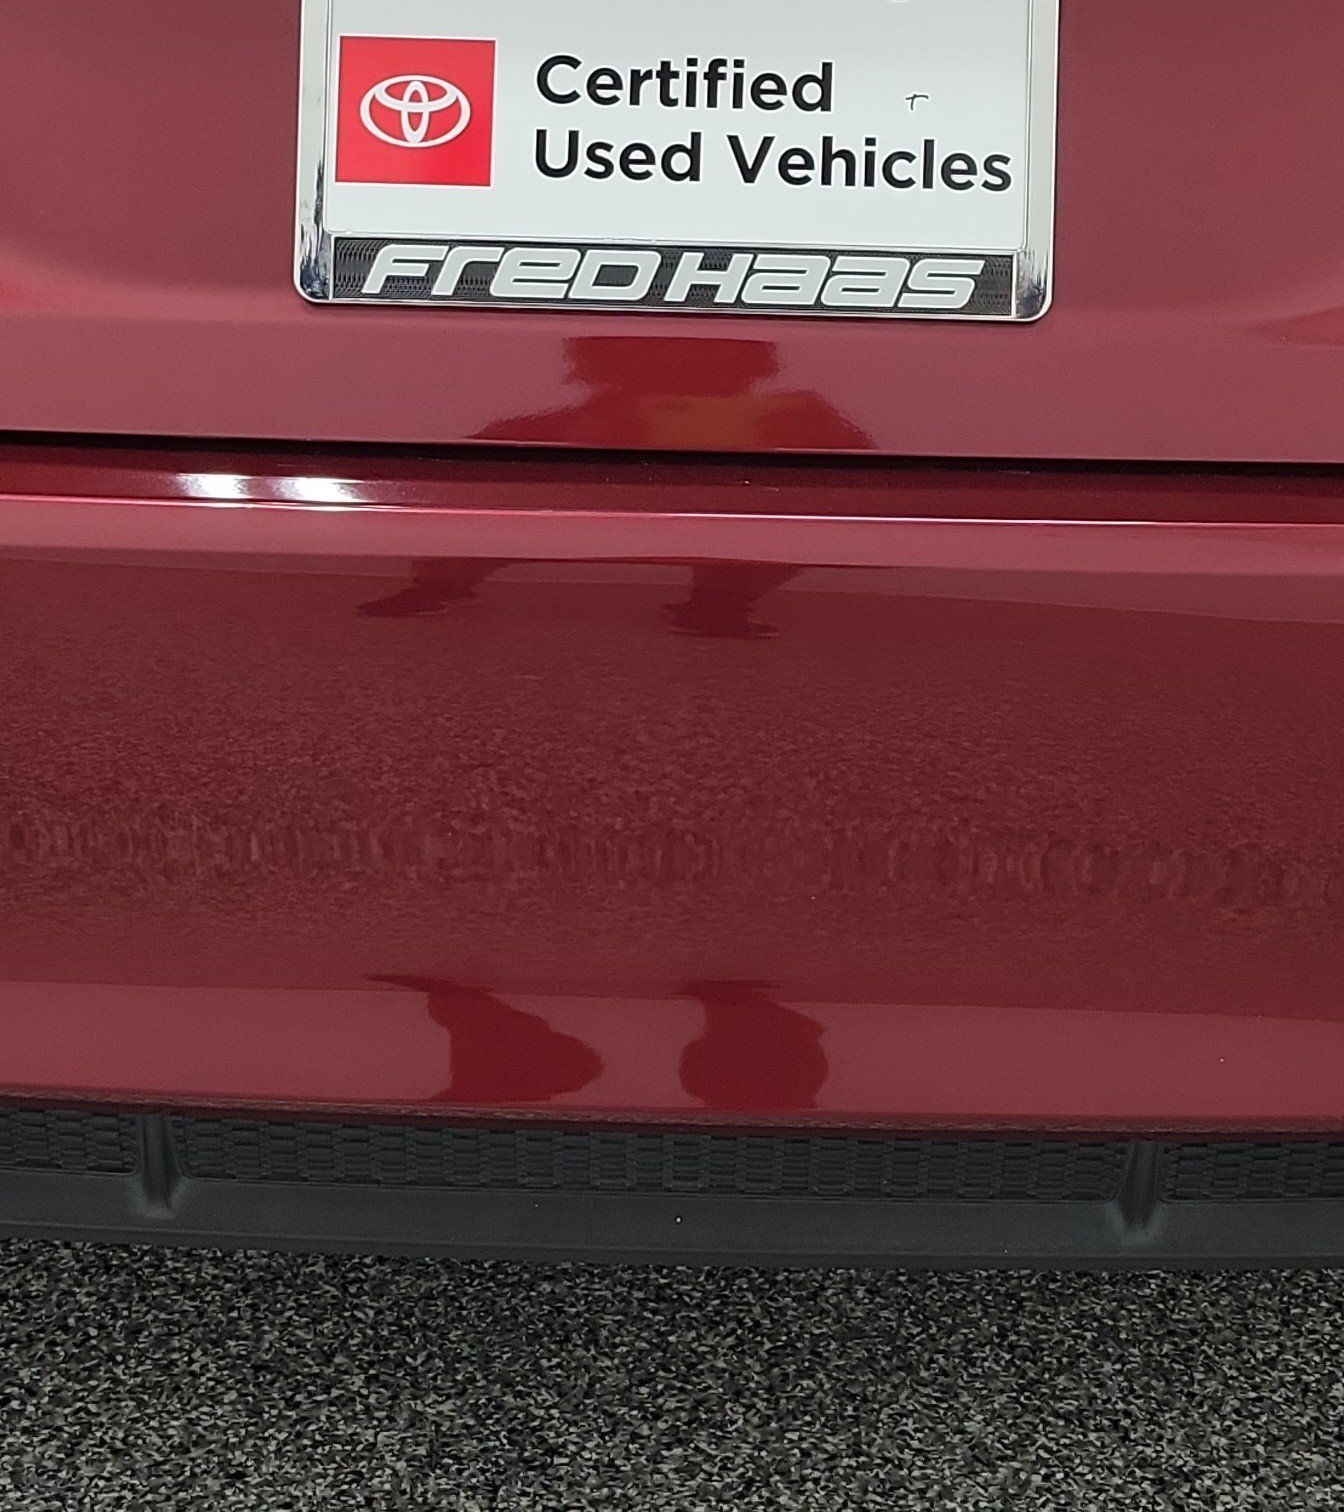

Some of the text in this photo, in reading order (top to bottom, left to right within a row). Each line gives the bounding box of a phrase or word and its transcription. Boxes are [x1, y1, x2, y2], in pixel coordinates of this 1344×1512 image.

[537, 55, 833, 112] Certified
[535, 129, 1013, 192] Used Vehicles
